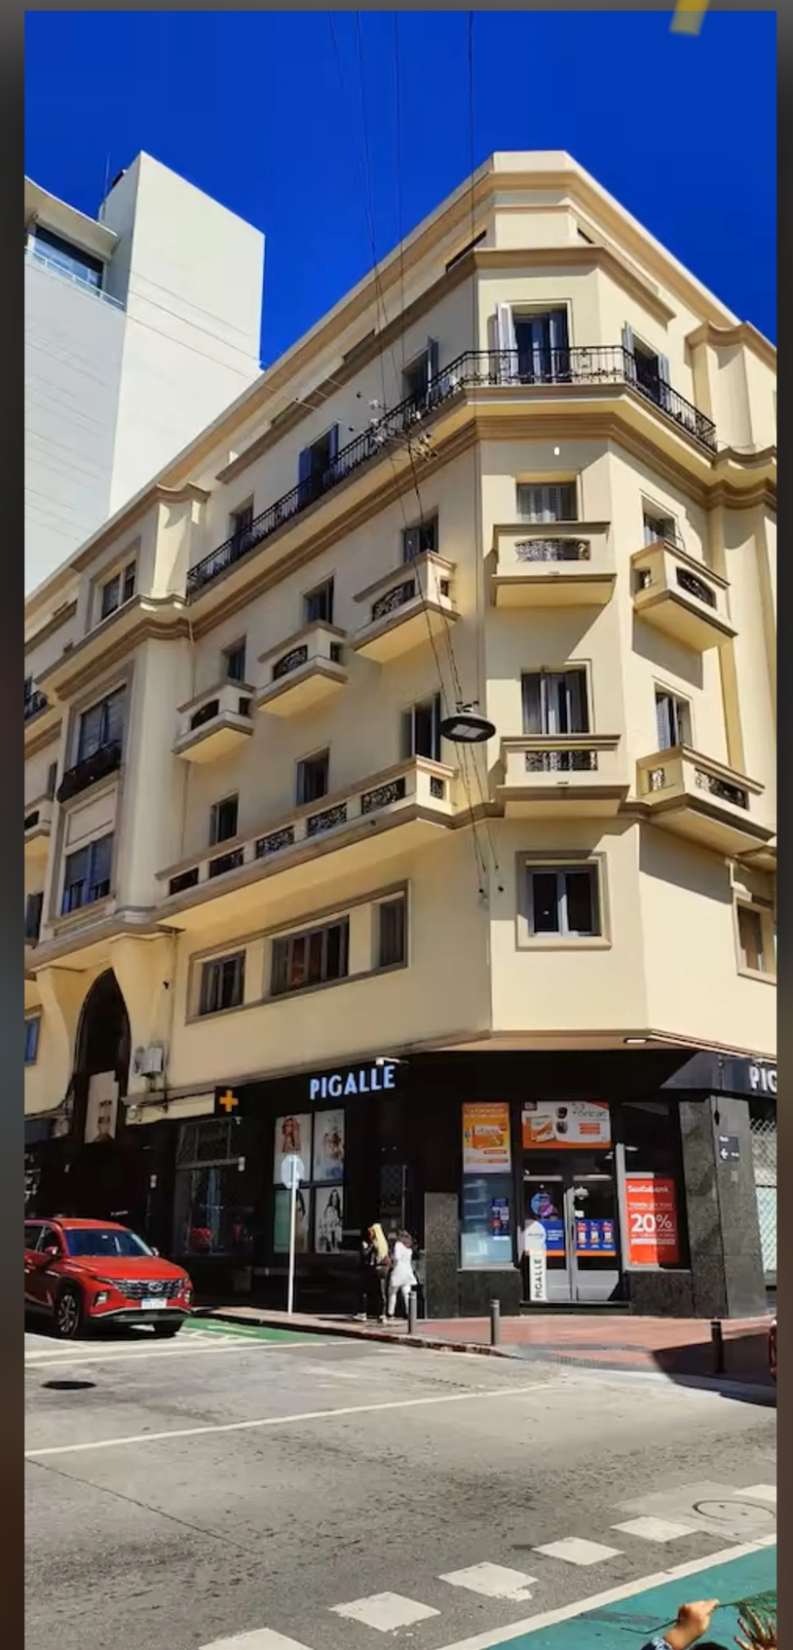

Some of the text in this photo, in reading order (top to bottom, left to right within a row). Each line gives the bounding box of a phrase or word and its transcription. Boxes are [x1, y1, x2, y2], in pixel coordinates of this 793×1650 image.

[309, 1064, 396, 1100] PIGALLE
[630, 1213, 673, 1233] 20%
[533, 1258, 543, 1299] PIGALLE
